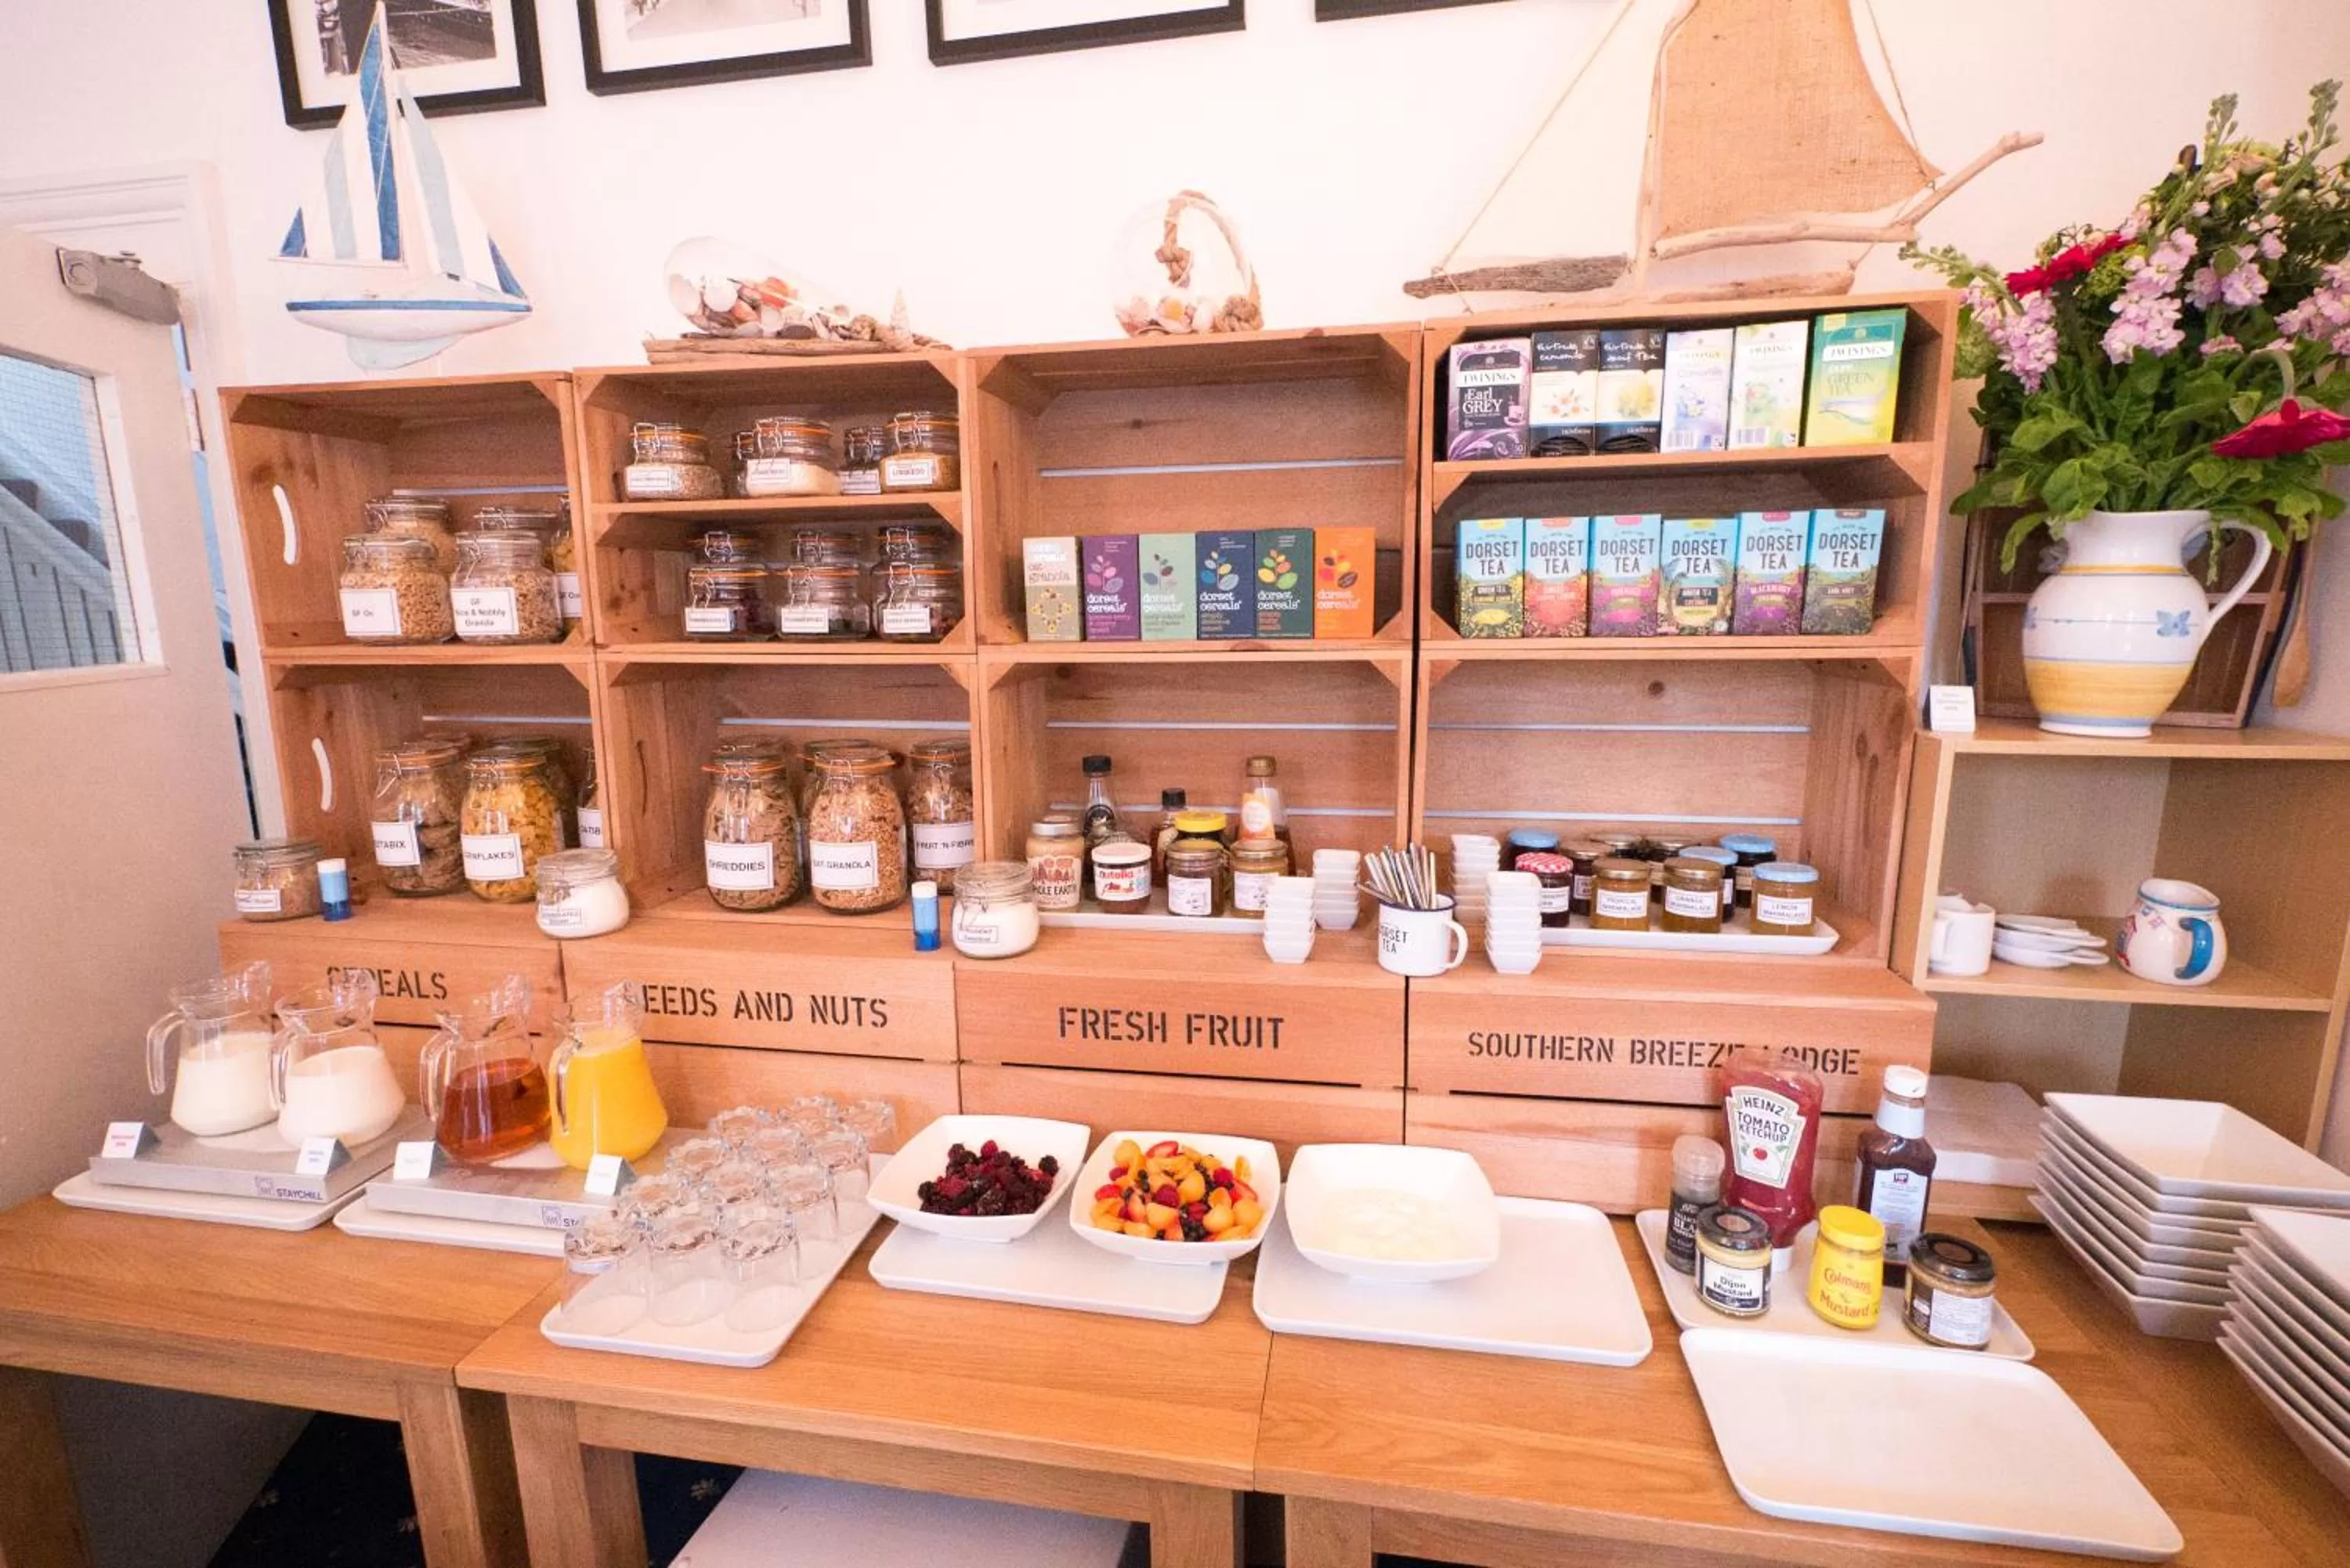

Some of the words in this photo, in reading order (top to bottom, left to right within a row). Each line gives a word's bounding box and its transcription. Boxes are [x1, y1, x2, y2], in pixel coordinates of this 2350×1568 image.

[1831, 346, 1887, 358] TWININGS
[1463, 372, 1517, 384] TWININGS
[1462, 399, 1503, 414] GREY
[1466, 541, 1520, 558] DORSET
[1530, 540, 1585, 558] DORSET
[1600, 538, 1654, 556] DORSET
[1672, 538, 1727, 556] DORSET
[1746, 535, 1804, 552] DORSET
[1818, 533, 1878, 551] DORSET
[1479, 559, 1505, 575] TEA
[1544, 558, 1570, 574] TEA
[1614, 557, 1640, 573] TEA
[1686, 557, 1712, 574] TEA
[1760, 553, 1787, 570] TEA
[1832, 551, 1859, 568] TEA
[327, 966, 448, 1000] CEALS
[642, 985, 718, 1017] EEDS
[733, 989, 794, 1022] AND
[810, 994, 888, 1028] NUTS
[1059, 1006, 1167, 1043] FRESH
[1186, 1013, 1285, 1050] FRUIT
[1467, 1031, 1614, 1064] SOUTHERN
[1762, 1045, 1860, 1075] ODGE
[1743, 1096, 1786, 1117] HEINZ
[1737, 1111, 1790, 1135] TOMATO
[1738, 1124, 1787, 1143] KETCHUP
[1820, 1289, 1870, 1317] Mustard
